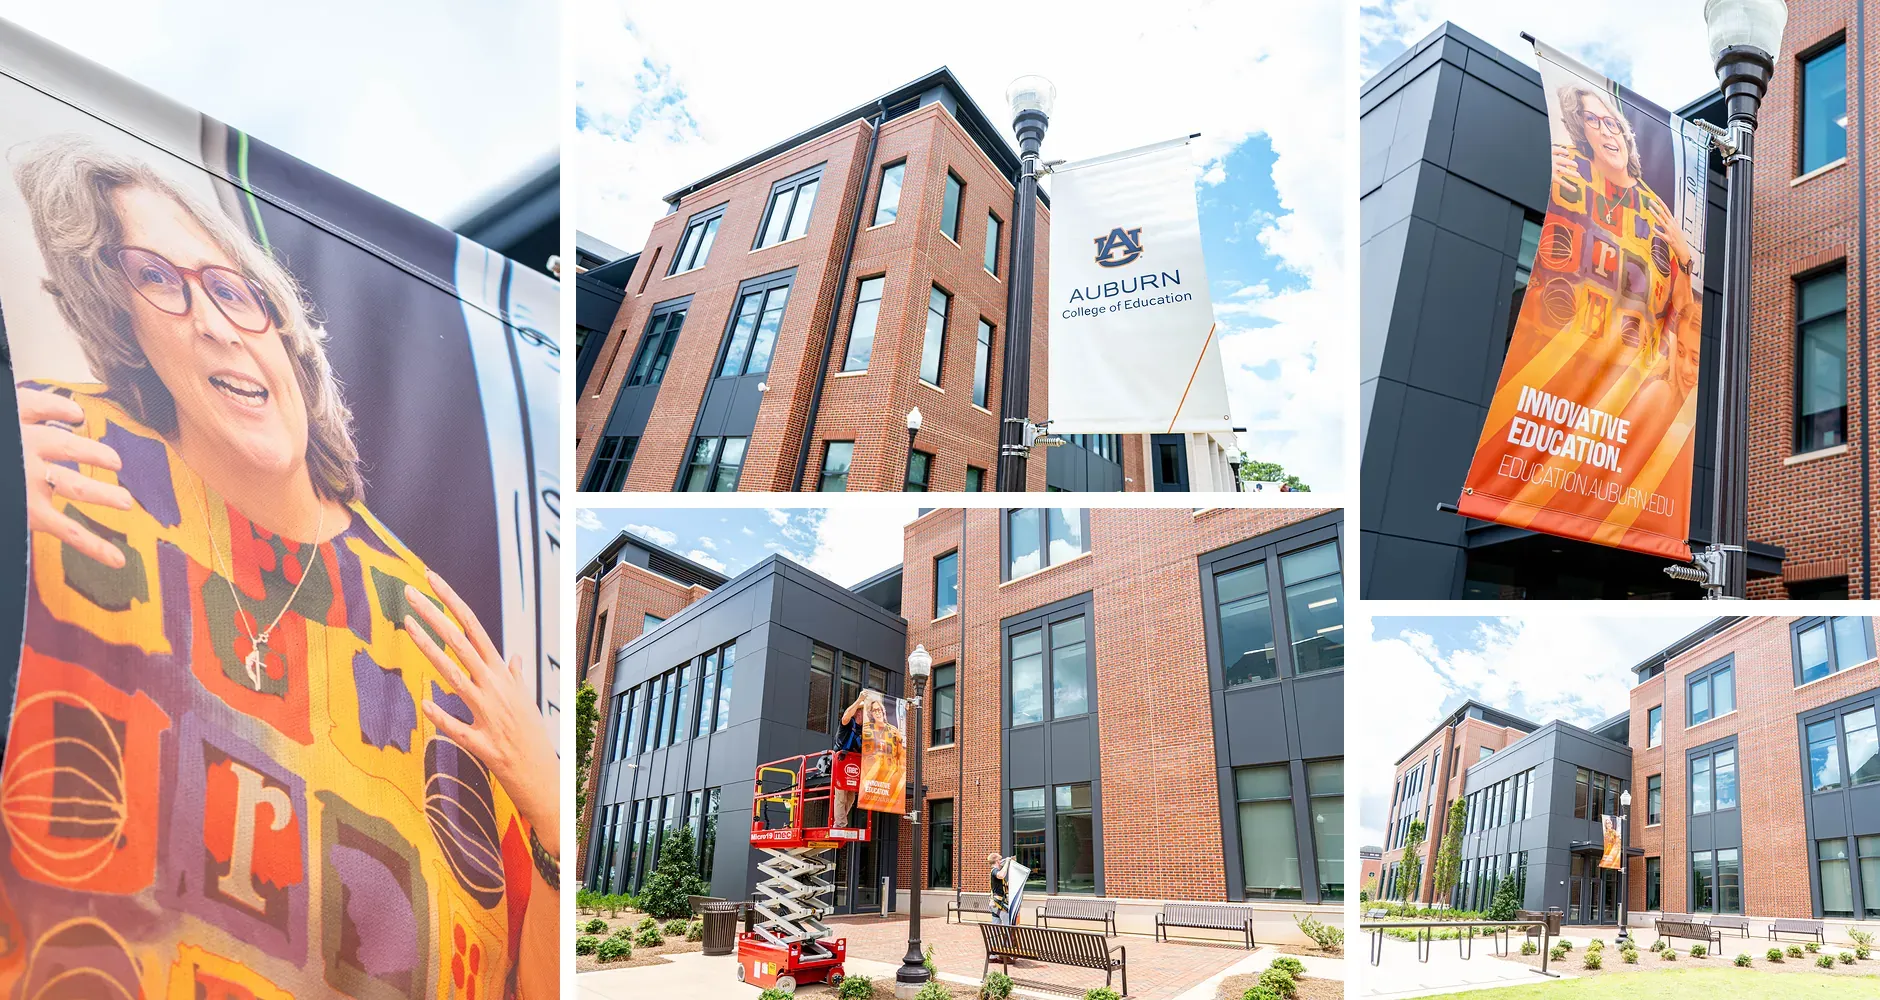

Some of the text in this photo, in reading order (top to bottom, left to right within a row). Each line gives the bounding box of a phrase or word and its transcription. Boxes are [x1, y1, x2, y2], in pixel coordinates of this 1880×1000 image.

[1062, 292, 1192, 319] College of Education
[1069, 269, 1181, 303] AUBURN
[1517, 385, 1631, 444] INNOVATIVE
[1507, 416, 1623, 474] EDUCATION.
[1498, 453, 1675, 517] EDUCATION.AUBURN.EDU
[750, 831, 792, 841] Micro19 mec
